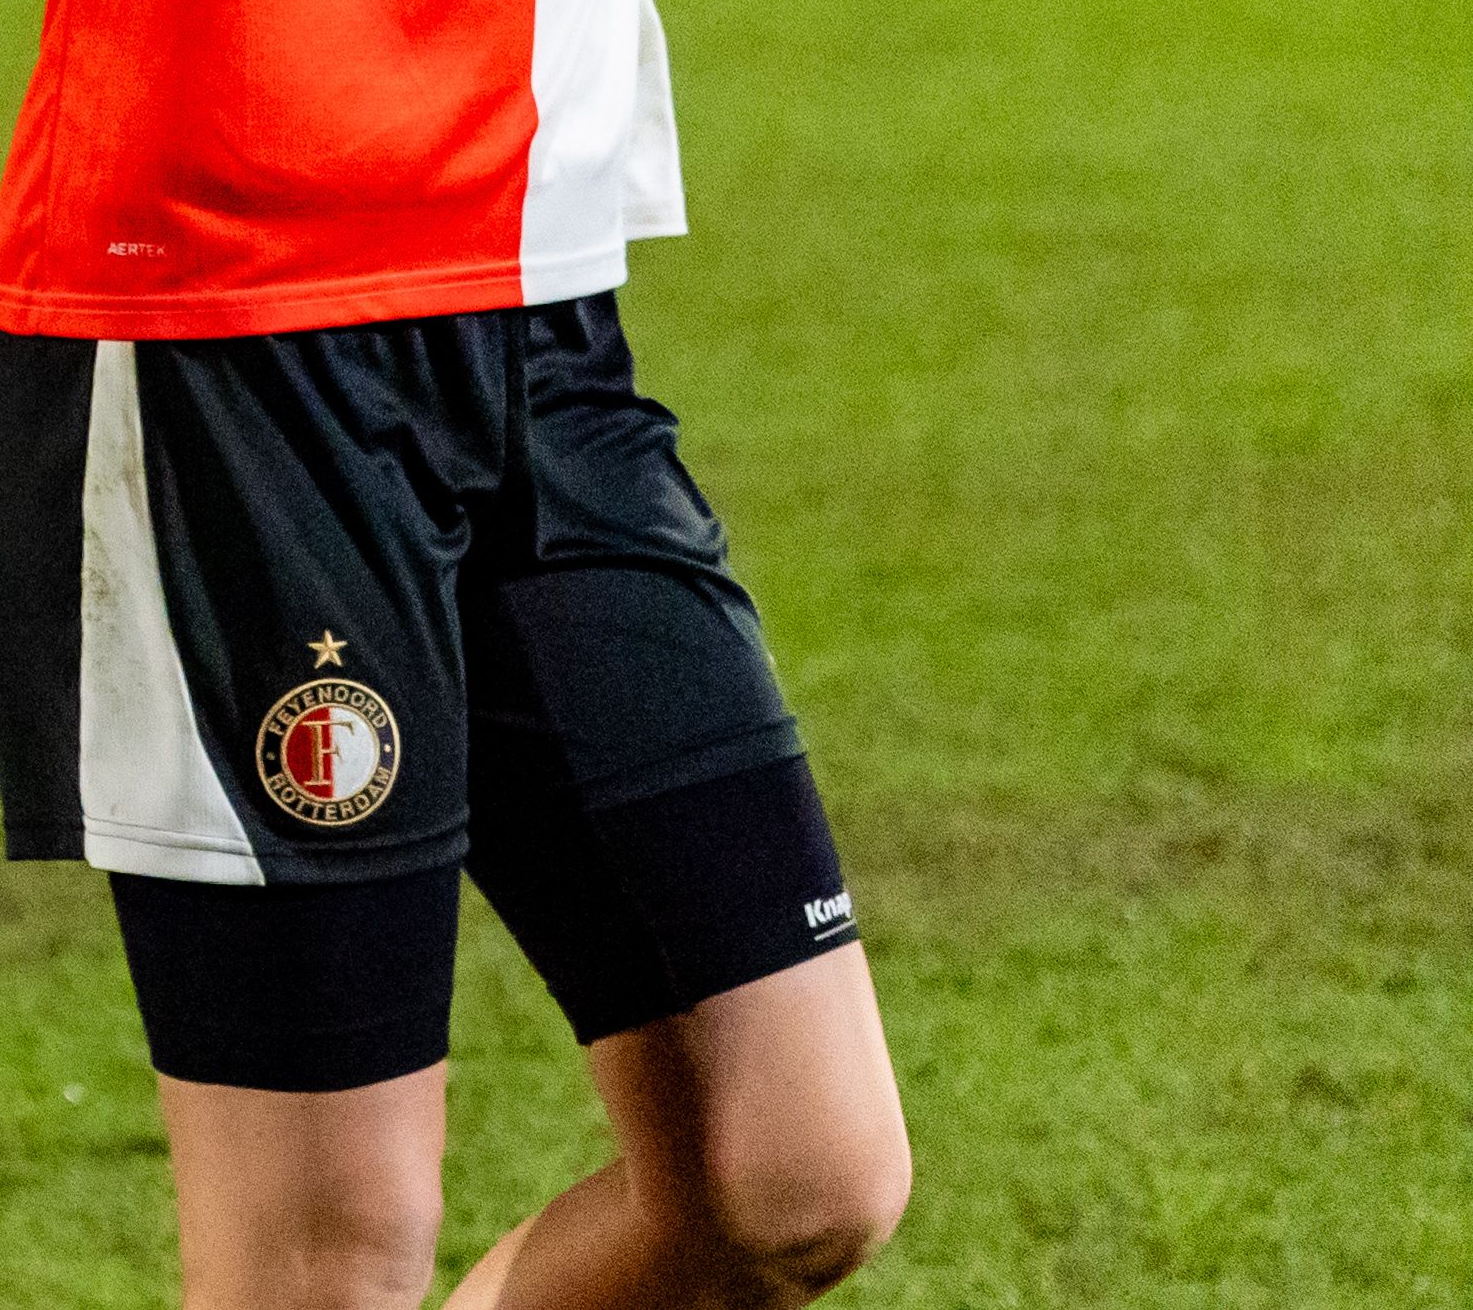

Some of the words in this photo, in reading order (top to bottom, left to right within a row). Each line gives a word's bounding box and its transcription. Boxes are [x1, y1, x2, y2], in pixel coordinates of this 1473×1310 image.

[107, 242, 168, 258] AERTEK
[268, 685, 389, 735] FEYENOORD
[301, 720, 356, 786] F
[267, 766, 392, 821] ROTTERDAM
